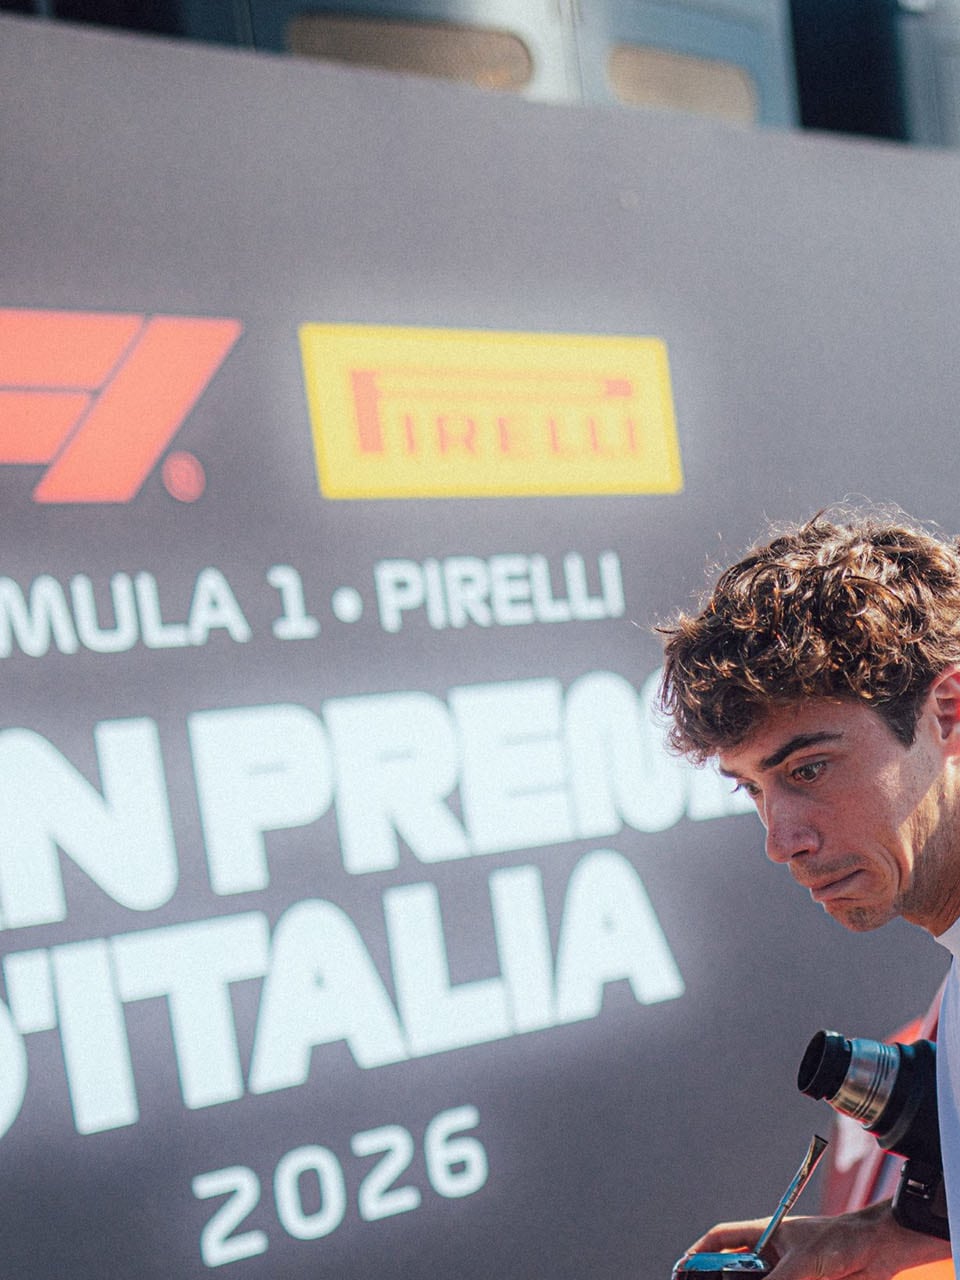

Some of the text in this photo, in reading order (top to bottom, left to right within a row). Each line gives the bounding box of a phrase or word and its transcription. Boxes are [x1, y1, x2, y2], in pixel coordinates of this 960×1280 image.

[350, 370, 641, 455] PIRELLI
[266, 562, 321, 640] 1
[374, 550, 627, 633] PIRELLI
[187, 667, 760, 896] PREM
[0, 848, 686, 1139] 'ITALIA
[192, 1104, 489, 1268] 2026
